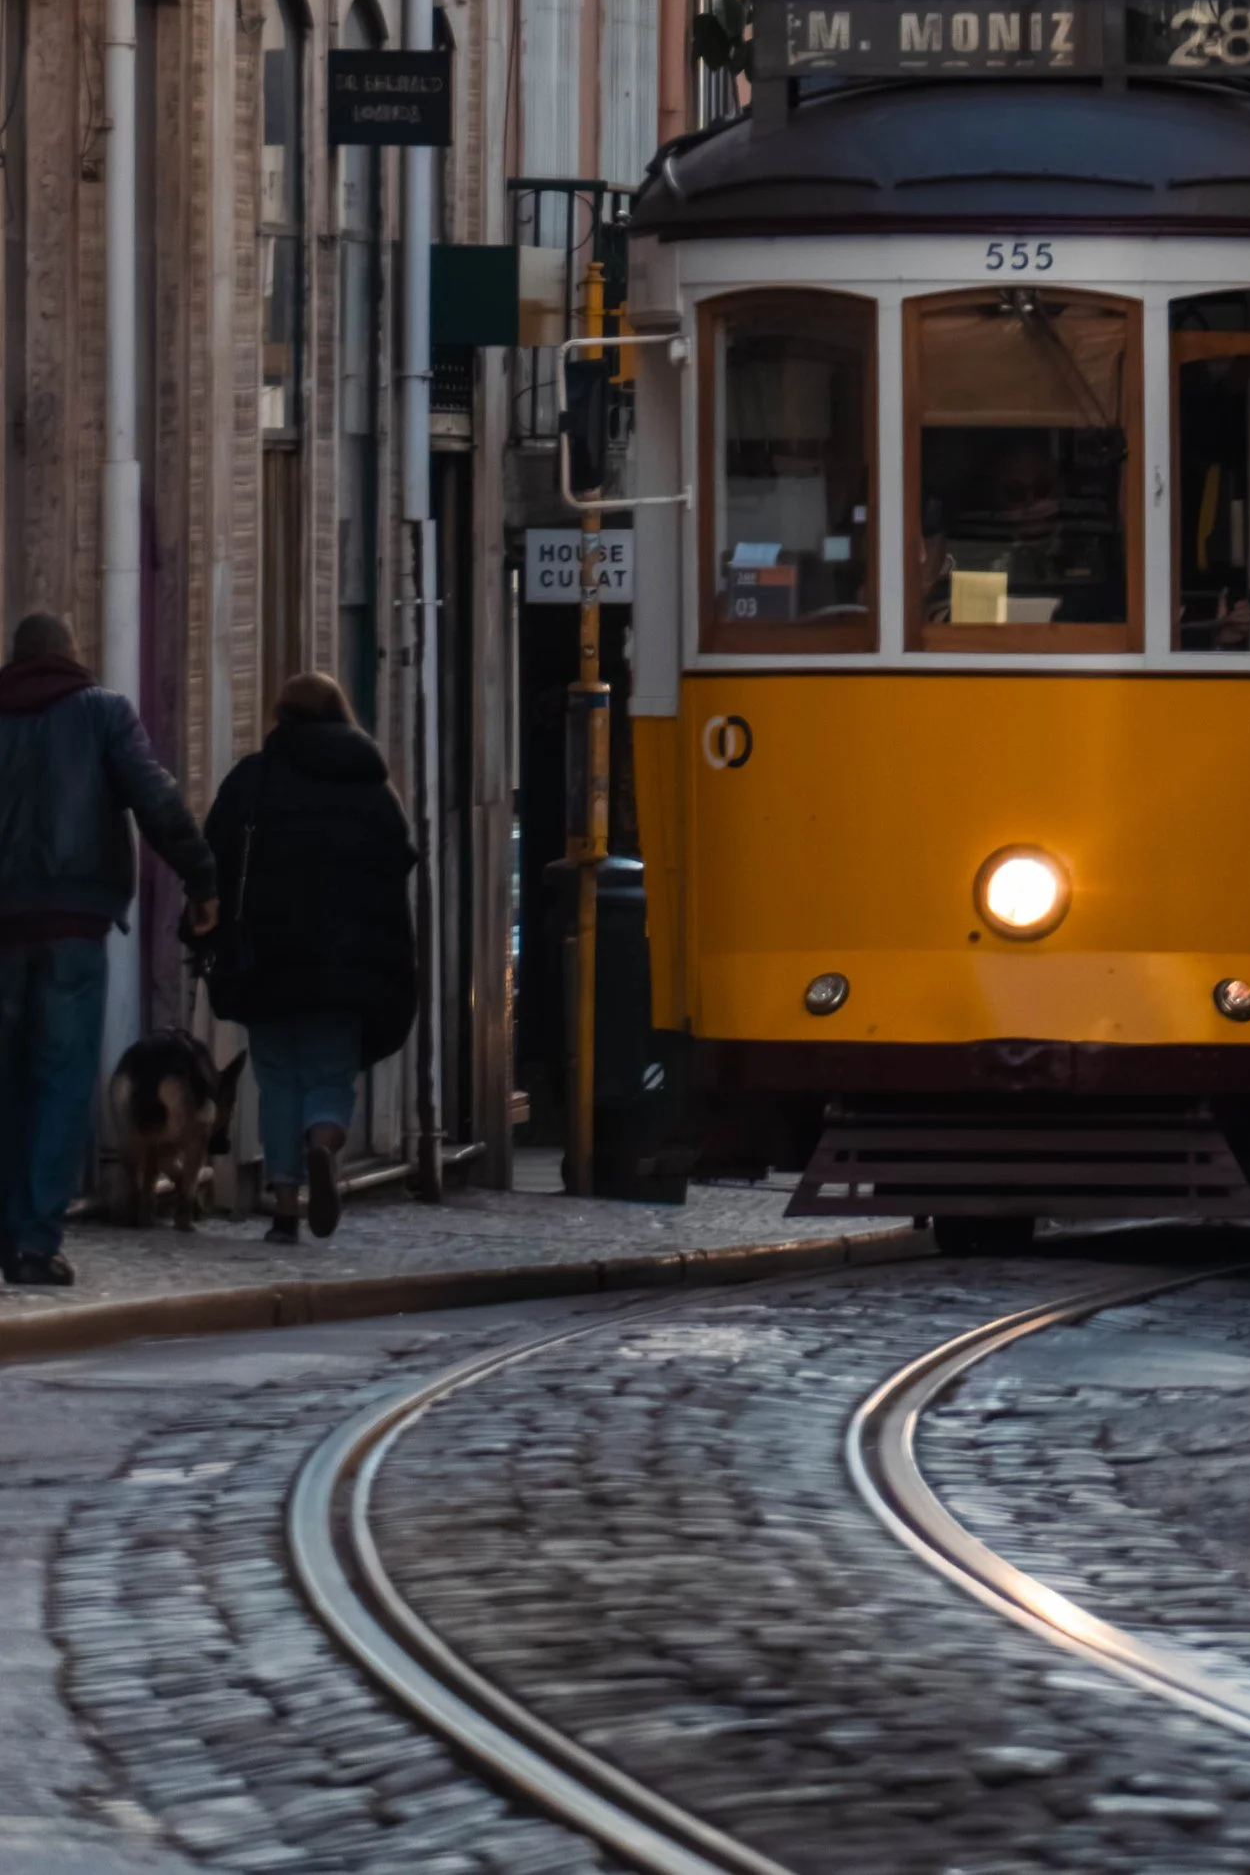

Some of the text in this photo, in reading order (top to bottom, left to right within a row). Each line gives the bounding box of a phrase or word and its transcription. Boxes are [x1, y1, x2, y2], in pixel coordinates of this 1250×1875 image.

[808, 10, 871, 52] M.
[900, 11, 1074, 53] MONIZ
[985, 241, 1054, 271] 555
[539, 569, 627, 588] CUAT
